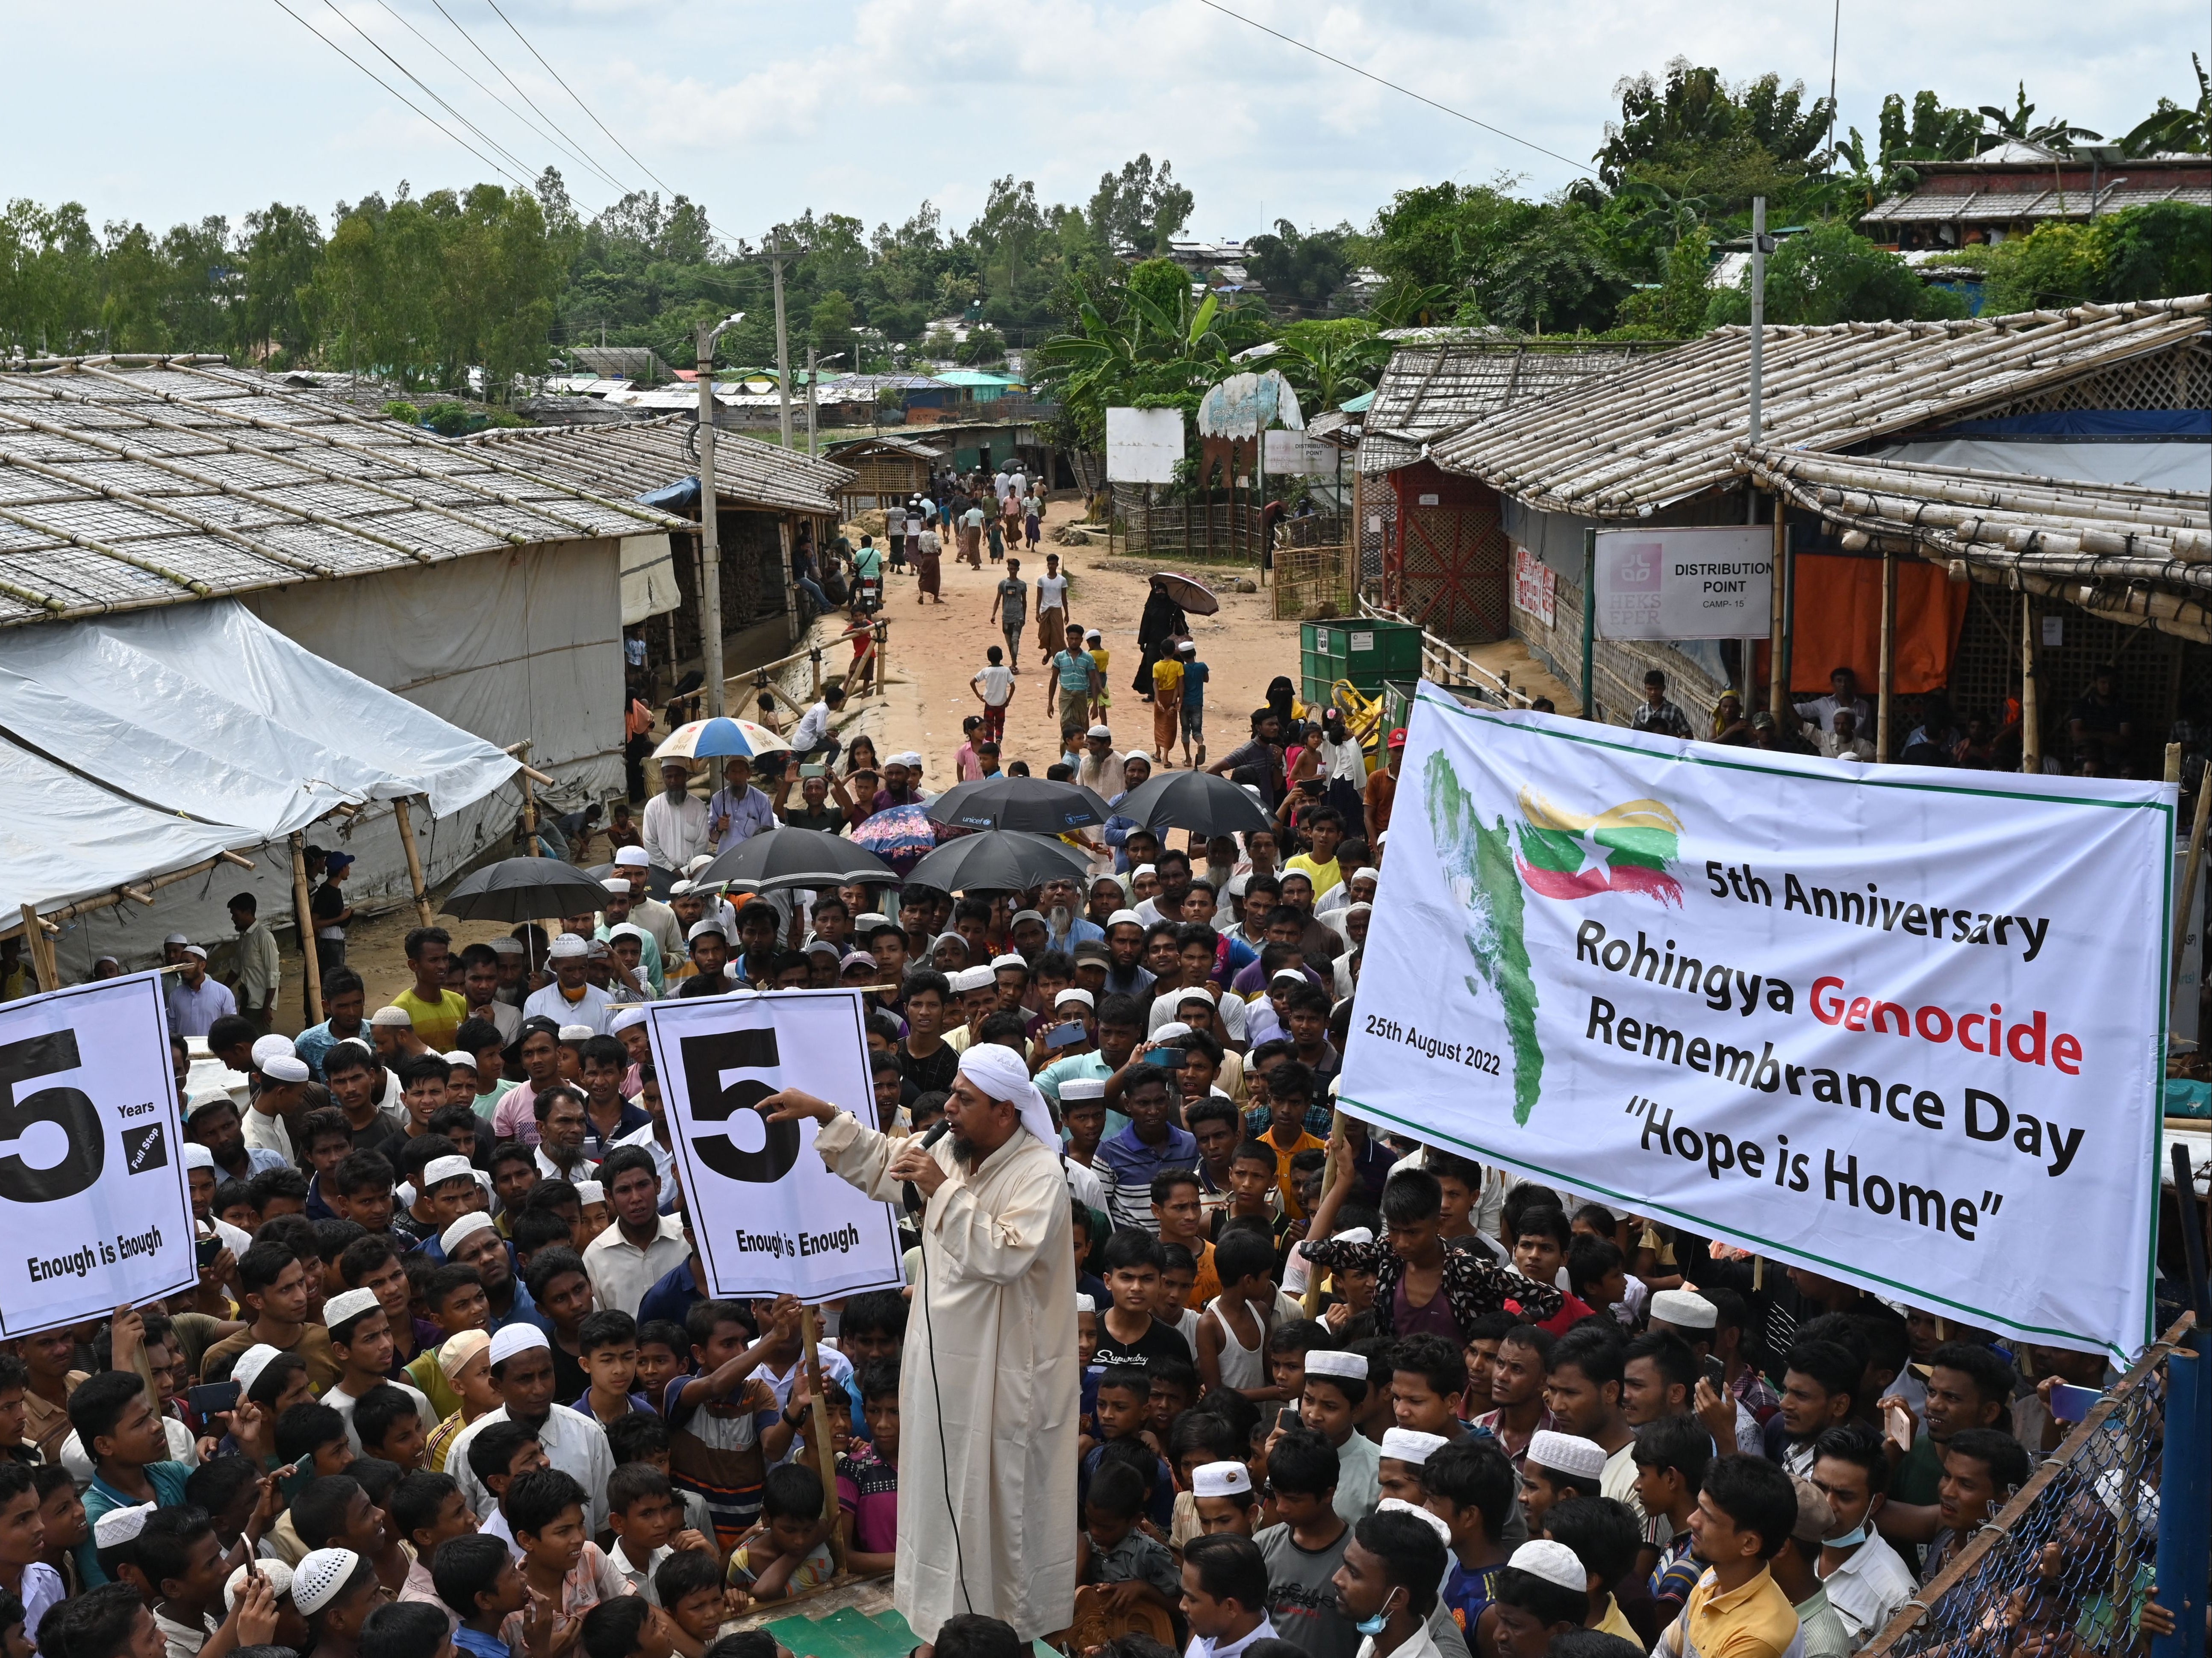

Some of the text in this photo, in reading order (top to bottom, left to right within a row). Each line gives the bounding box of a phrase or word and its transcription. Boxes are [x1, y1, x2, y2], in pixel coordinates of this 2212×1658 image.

[1610, 594, 1661, 610] HEKS
[1703, 580, 1747, 593] POINT
[1735, 599, 1744, 608] 15
[1610, 611, 1660, 625] EPER
[962, 816, 984, 825] unicef
[1706, 861, 2050, 962] 5th Anniversary
[1577, 920, 2083, 1075] Rohingya Genocide
[1365, 1015, 1500, 1076] 25th August 2022
[117, 1100, 154, 1119] Years
[680, 1027, 801, 1183] 5
[1586, 996, 2085, 1177] Remembrance Day
[0, 1028, 105, 1204] 5
[131, 1127, 159, 1169] Full Stop
[1775, 1135, 1809, 1192] is
[27, 1224, 163, 1283] Enough is Enough
[736, 1222, 860, 1259] Enough is Enough
